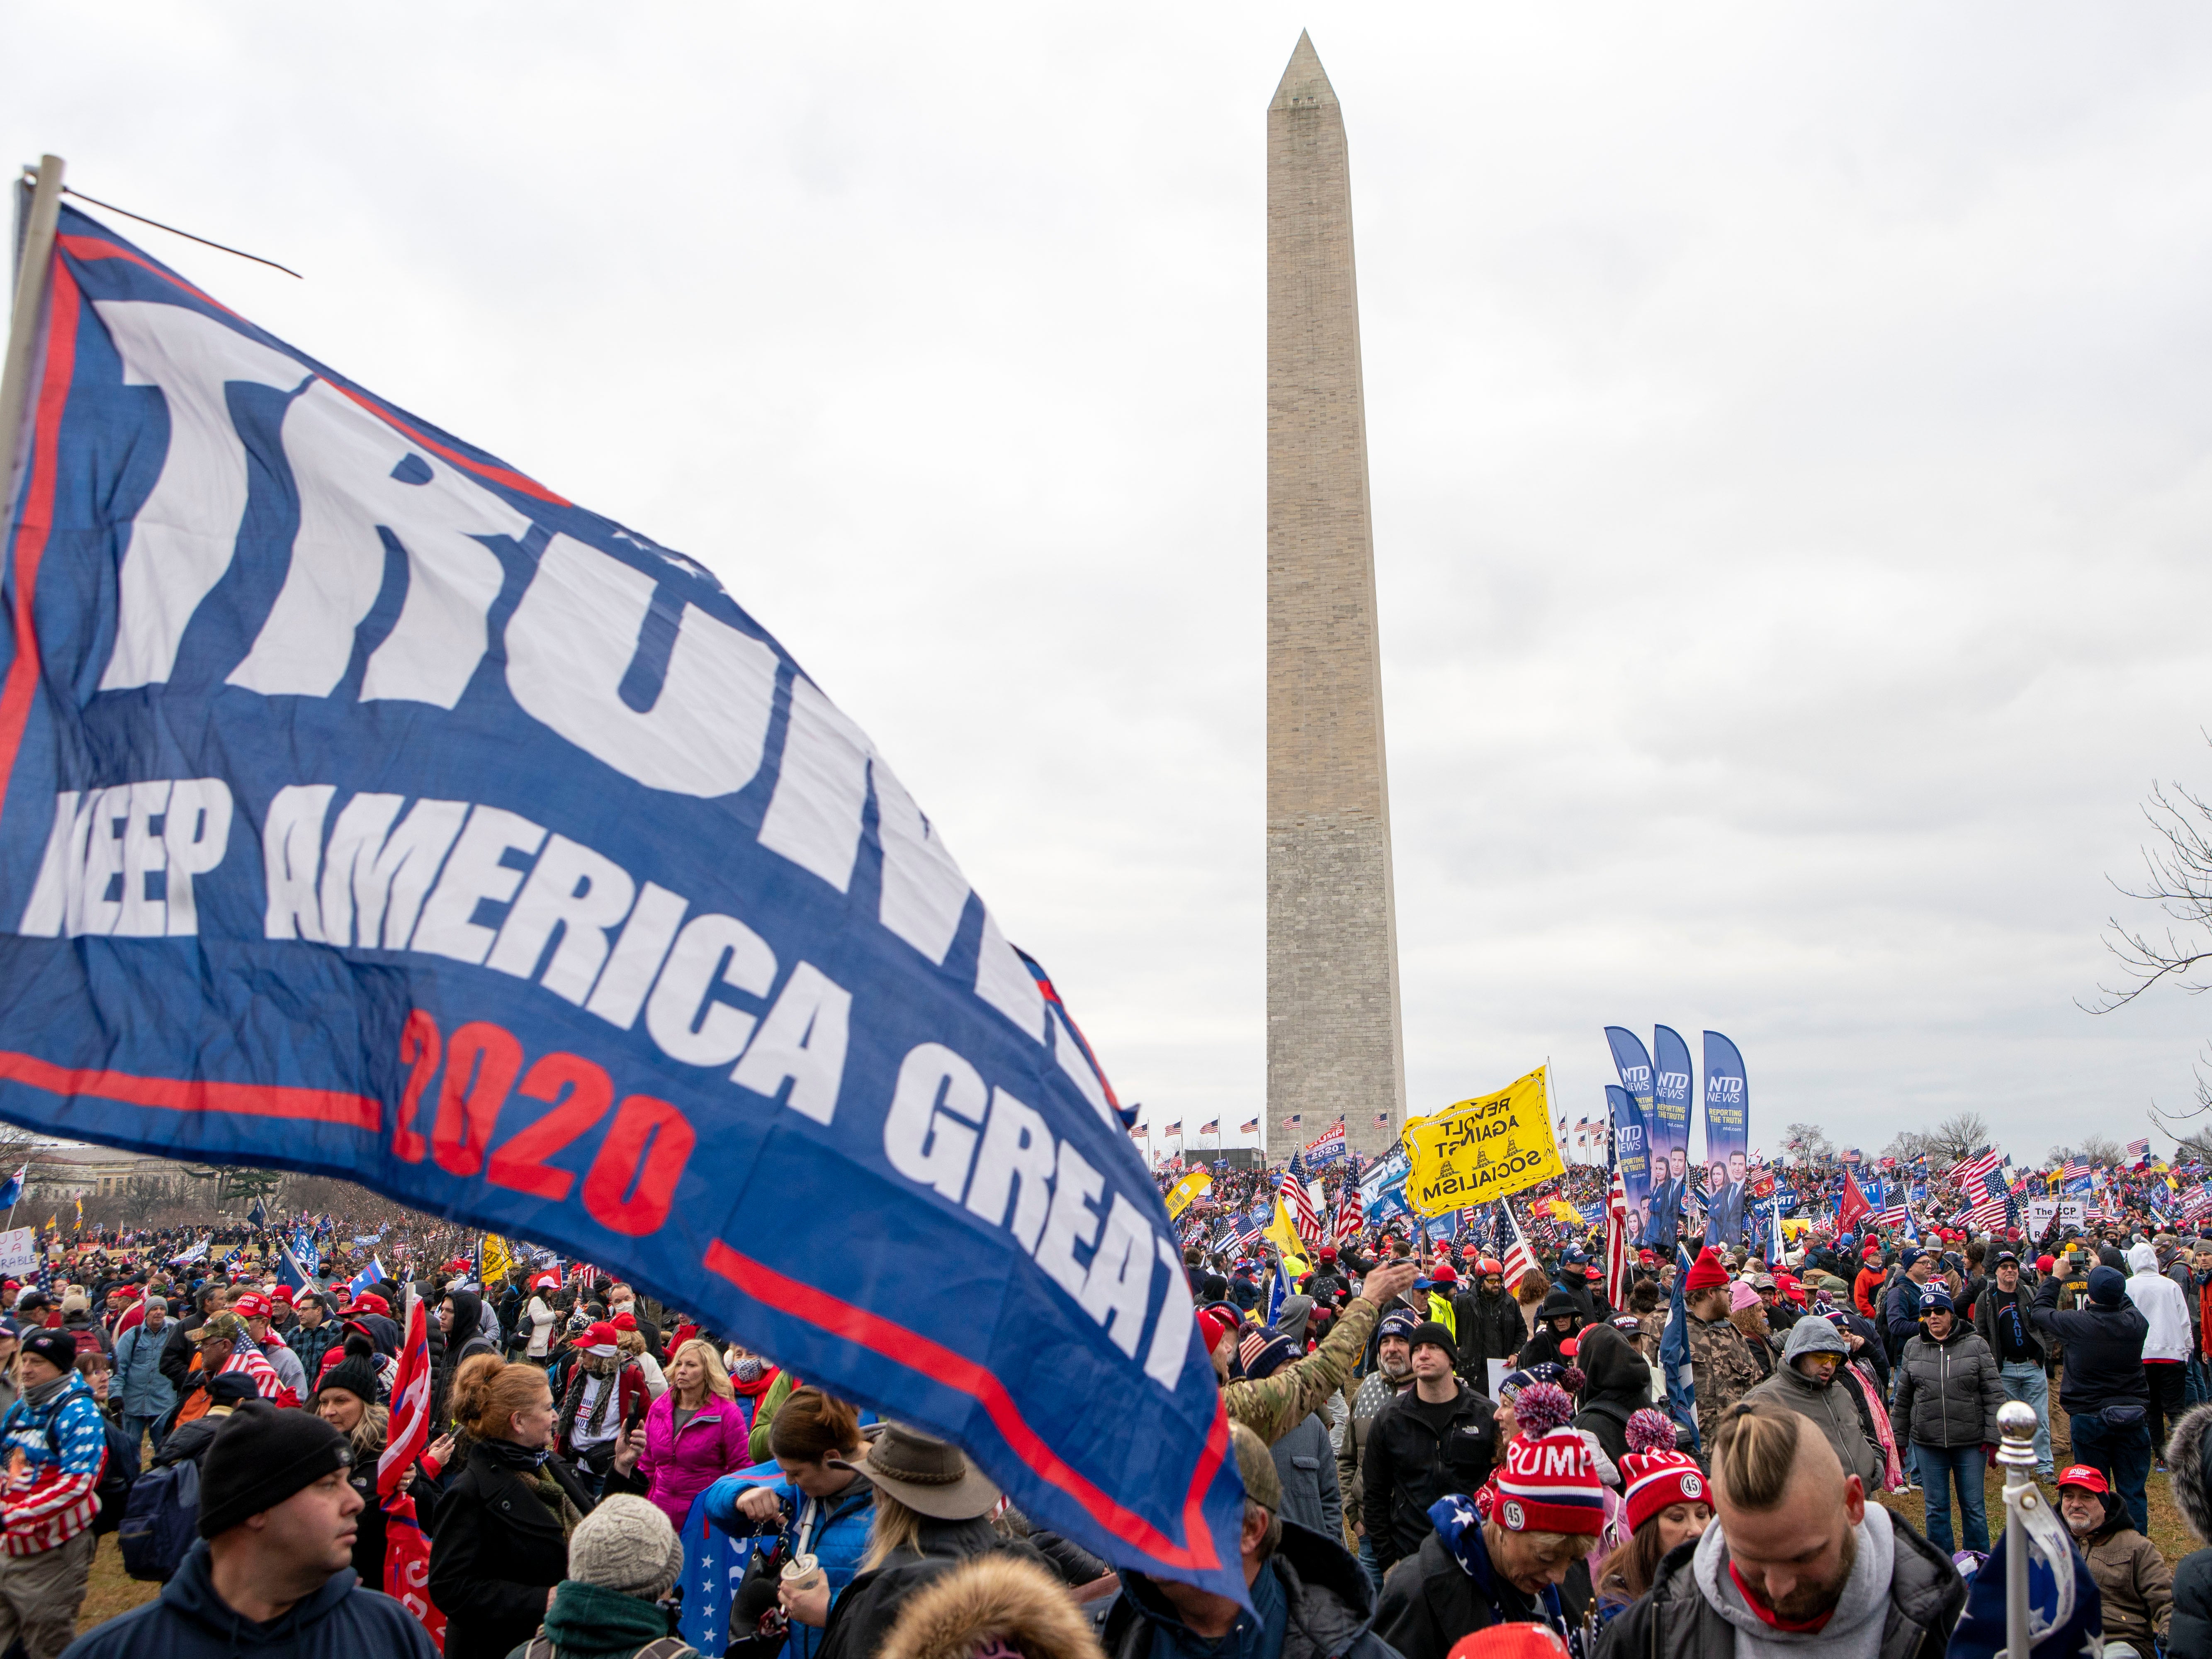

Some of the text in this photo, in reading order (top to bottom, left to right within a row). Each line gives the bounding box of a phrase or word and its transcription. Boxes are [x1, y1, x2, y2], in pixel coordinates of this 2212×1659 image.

[1621, 1065, 1650, 1082] NTD
[18, 777, 1197, 1392] KEEP AMERICA GREAT
[1625, 1080, 1649, 1092] NEWS
[1657, 1071, 1689, 1090] NTD
[1709, 1076, 1743, 1092] NTD
[1655, 1087, 1685, 1100] NEWS
[1706, 1092, 1740, 1103] NEWS
[1657, 1103, 1686, 1114] REPORTING
[1709, 1108, 1742, 1117] REPORTING
[391, 1008, 695, 1237] 2020
[1666, 1112, 1685, 1121] TRUTH
[1710, 1115, 1742, 1124] THE TRUTH
[1616, 1125, 1642, 1143] NTD
[1311, 1145, 1339, 1160] 2020
[1629, 1163, 1645, 1172] TRUTH
[1168, 1199, 1179, 1211] LIVES
[1173, 1192, 1186, 1206] TRUTH
[1613, 1316, 1638, 1326] TRUMP
[2009, 1302, 2023, 1346] FRAUD
[578, 1406, 590, 1416] LEG
[576, 1418, 589, 1428] VOT
[1507, 1441, 1594, 1477] RUMP
[1623, 1445, 1697, 1478] TRU
[1686, 1479, 1698, 1491] 45
[1508, 1507, 1520, 1523] 45
